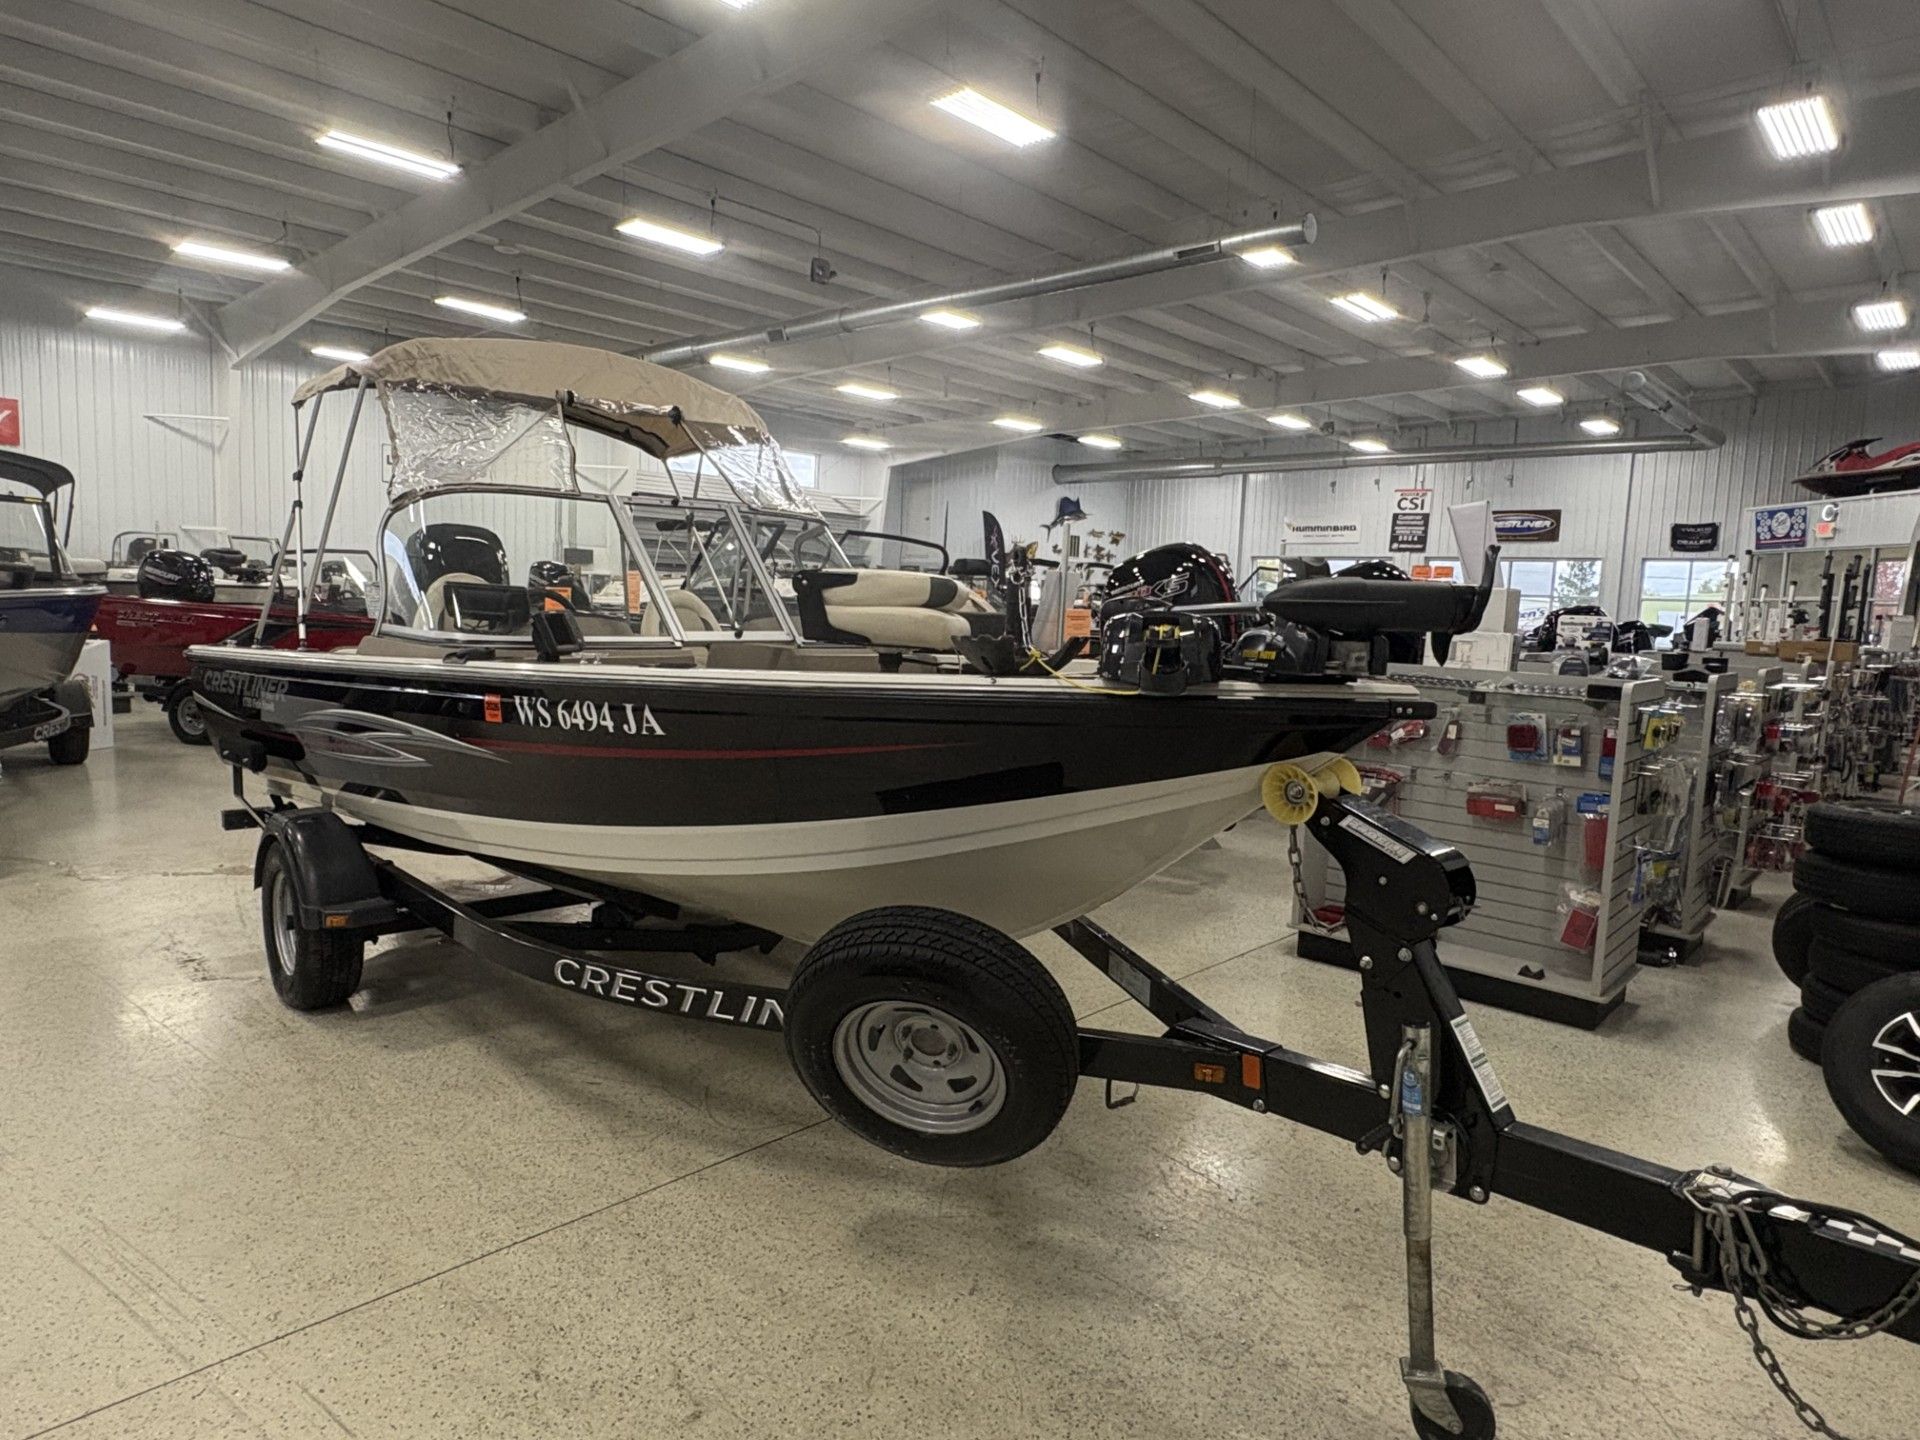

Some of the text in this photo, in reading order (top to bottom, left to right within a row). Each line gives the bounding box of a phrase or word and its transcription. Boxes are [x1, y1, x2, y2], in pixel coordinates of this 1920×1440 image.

[1397, 497, 1425, 511] CSI
[203, 670, 289, 702] CRESTLINER
[514, 695, 667, 736] WS 6494 JA
